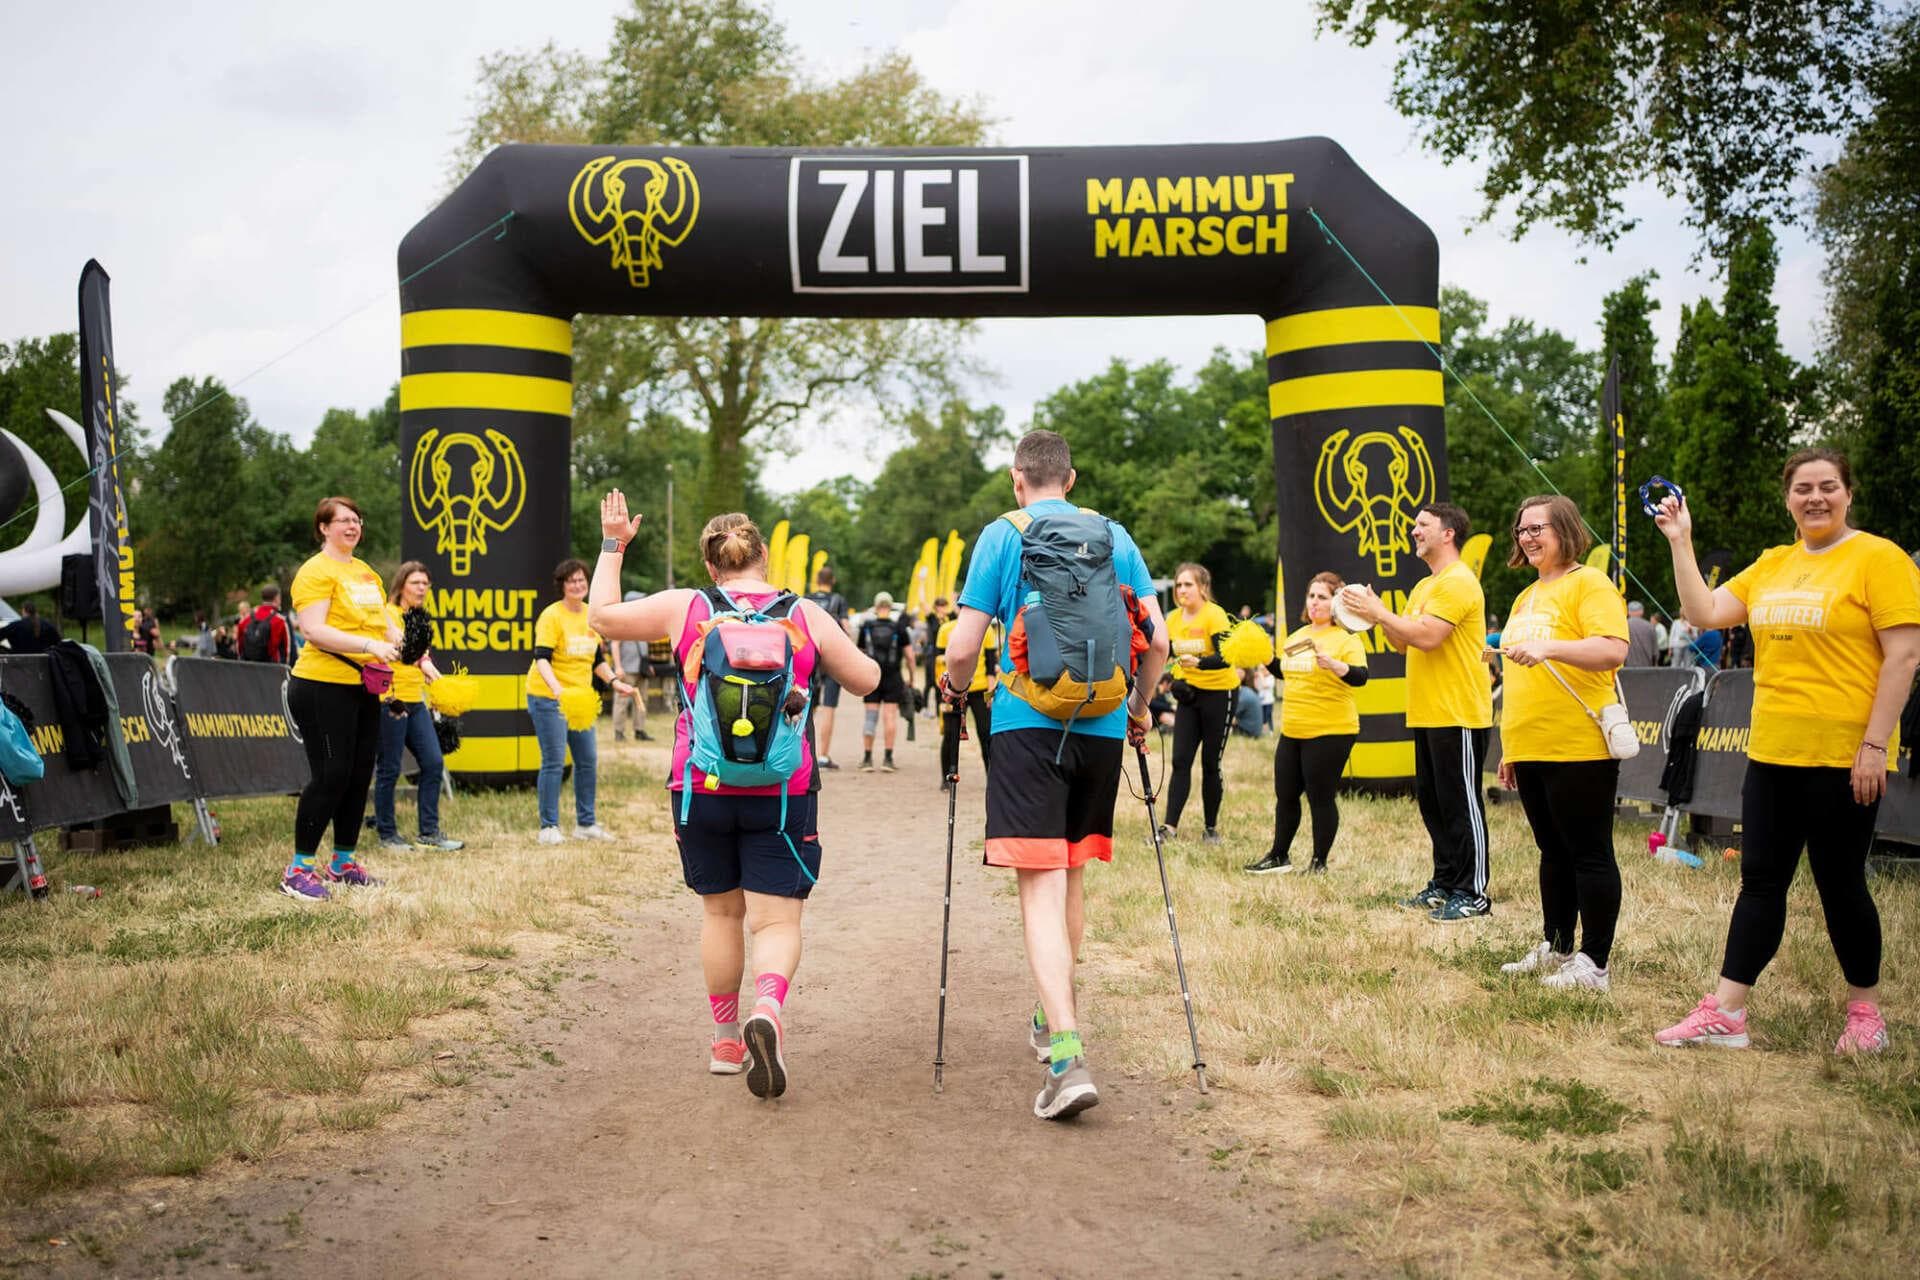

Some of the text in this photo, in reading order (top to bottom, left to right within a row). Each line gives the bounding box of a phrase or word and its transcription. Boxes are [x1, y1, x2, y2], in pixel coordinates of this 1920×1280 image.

[1086, 173, 1294, 215] MAMMUT
[818, 169, 1006, 272] ZIEL
[1094, 213, 1288, 258] MARSCH
[423, 588, 538, 619] AMMUT
[430, 620, 533, 651] ARSCH
[185, 713, 290, 738] MAMMUTMARSCH
[1696, 727, 1750, 752] MAMMU
